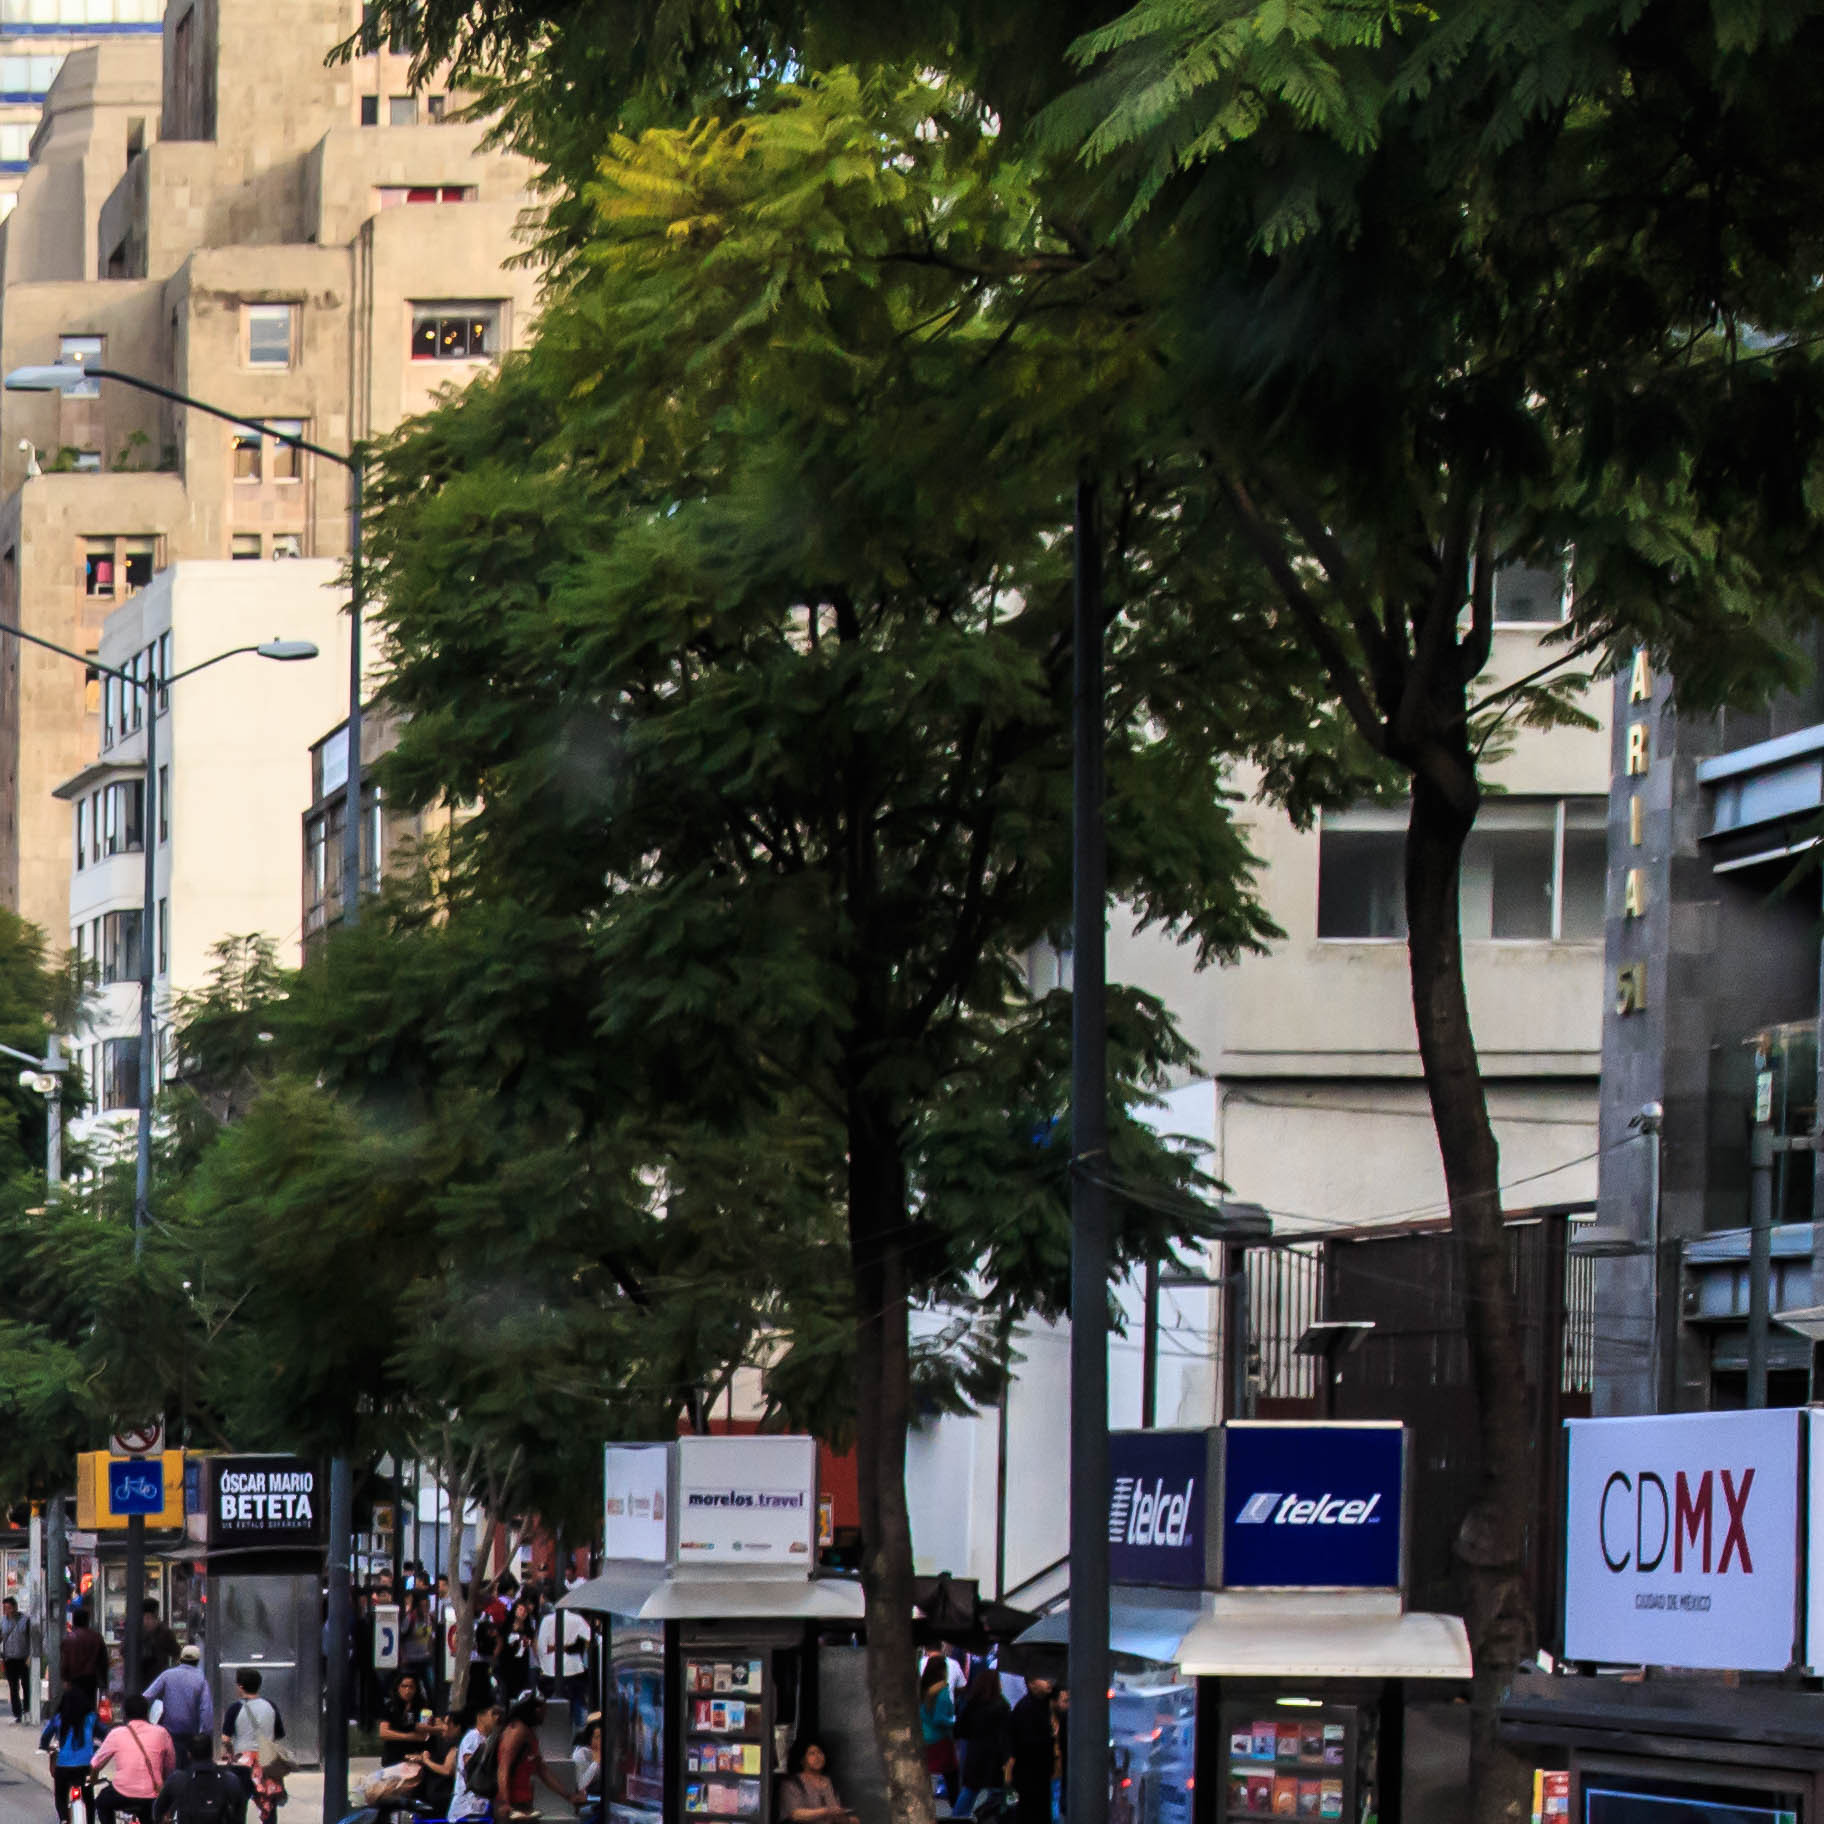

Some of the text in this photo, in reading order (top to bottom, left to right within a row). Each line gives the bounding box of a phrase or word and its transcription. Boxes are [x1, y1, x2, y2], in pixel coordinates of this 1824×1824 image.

[220, 1469, 313, 1493] ÓSCAR MARIO
[221, 1494, 312, 1520] BETETA
[1128, 1478, 1194, 1546] telcel
[1274, 1493, 1381, 1525] telcel
[1600, 1468, 1756, 1574] CDMX
